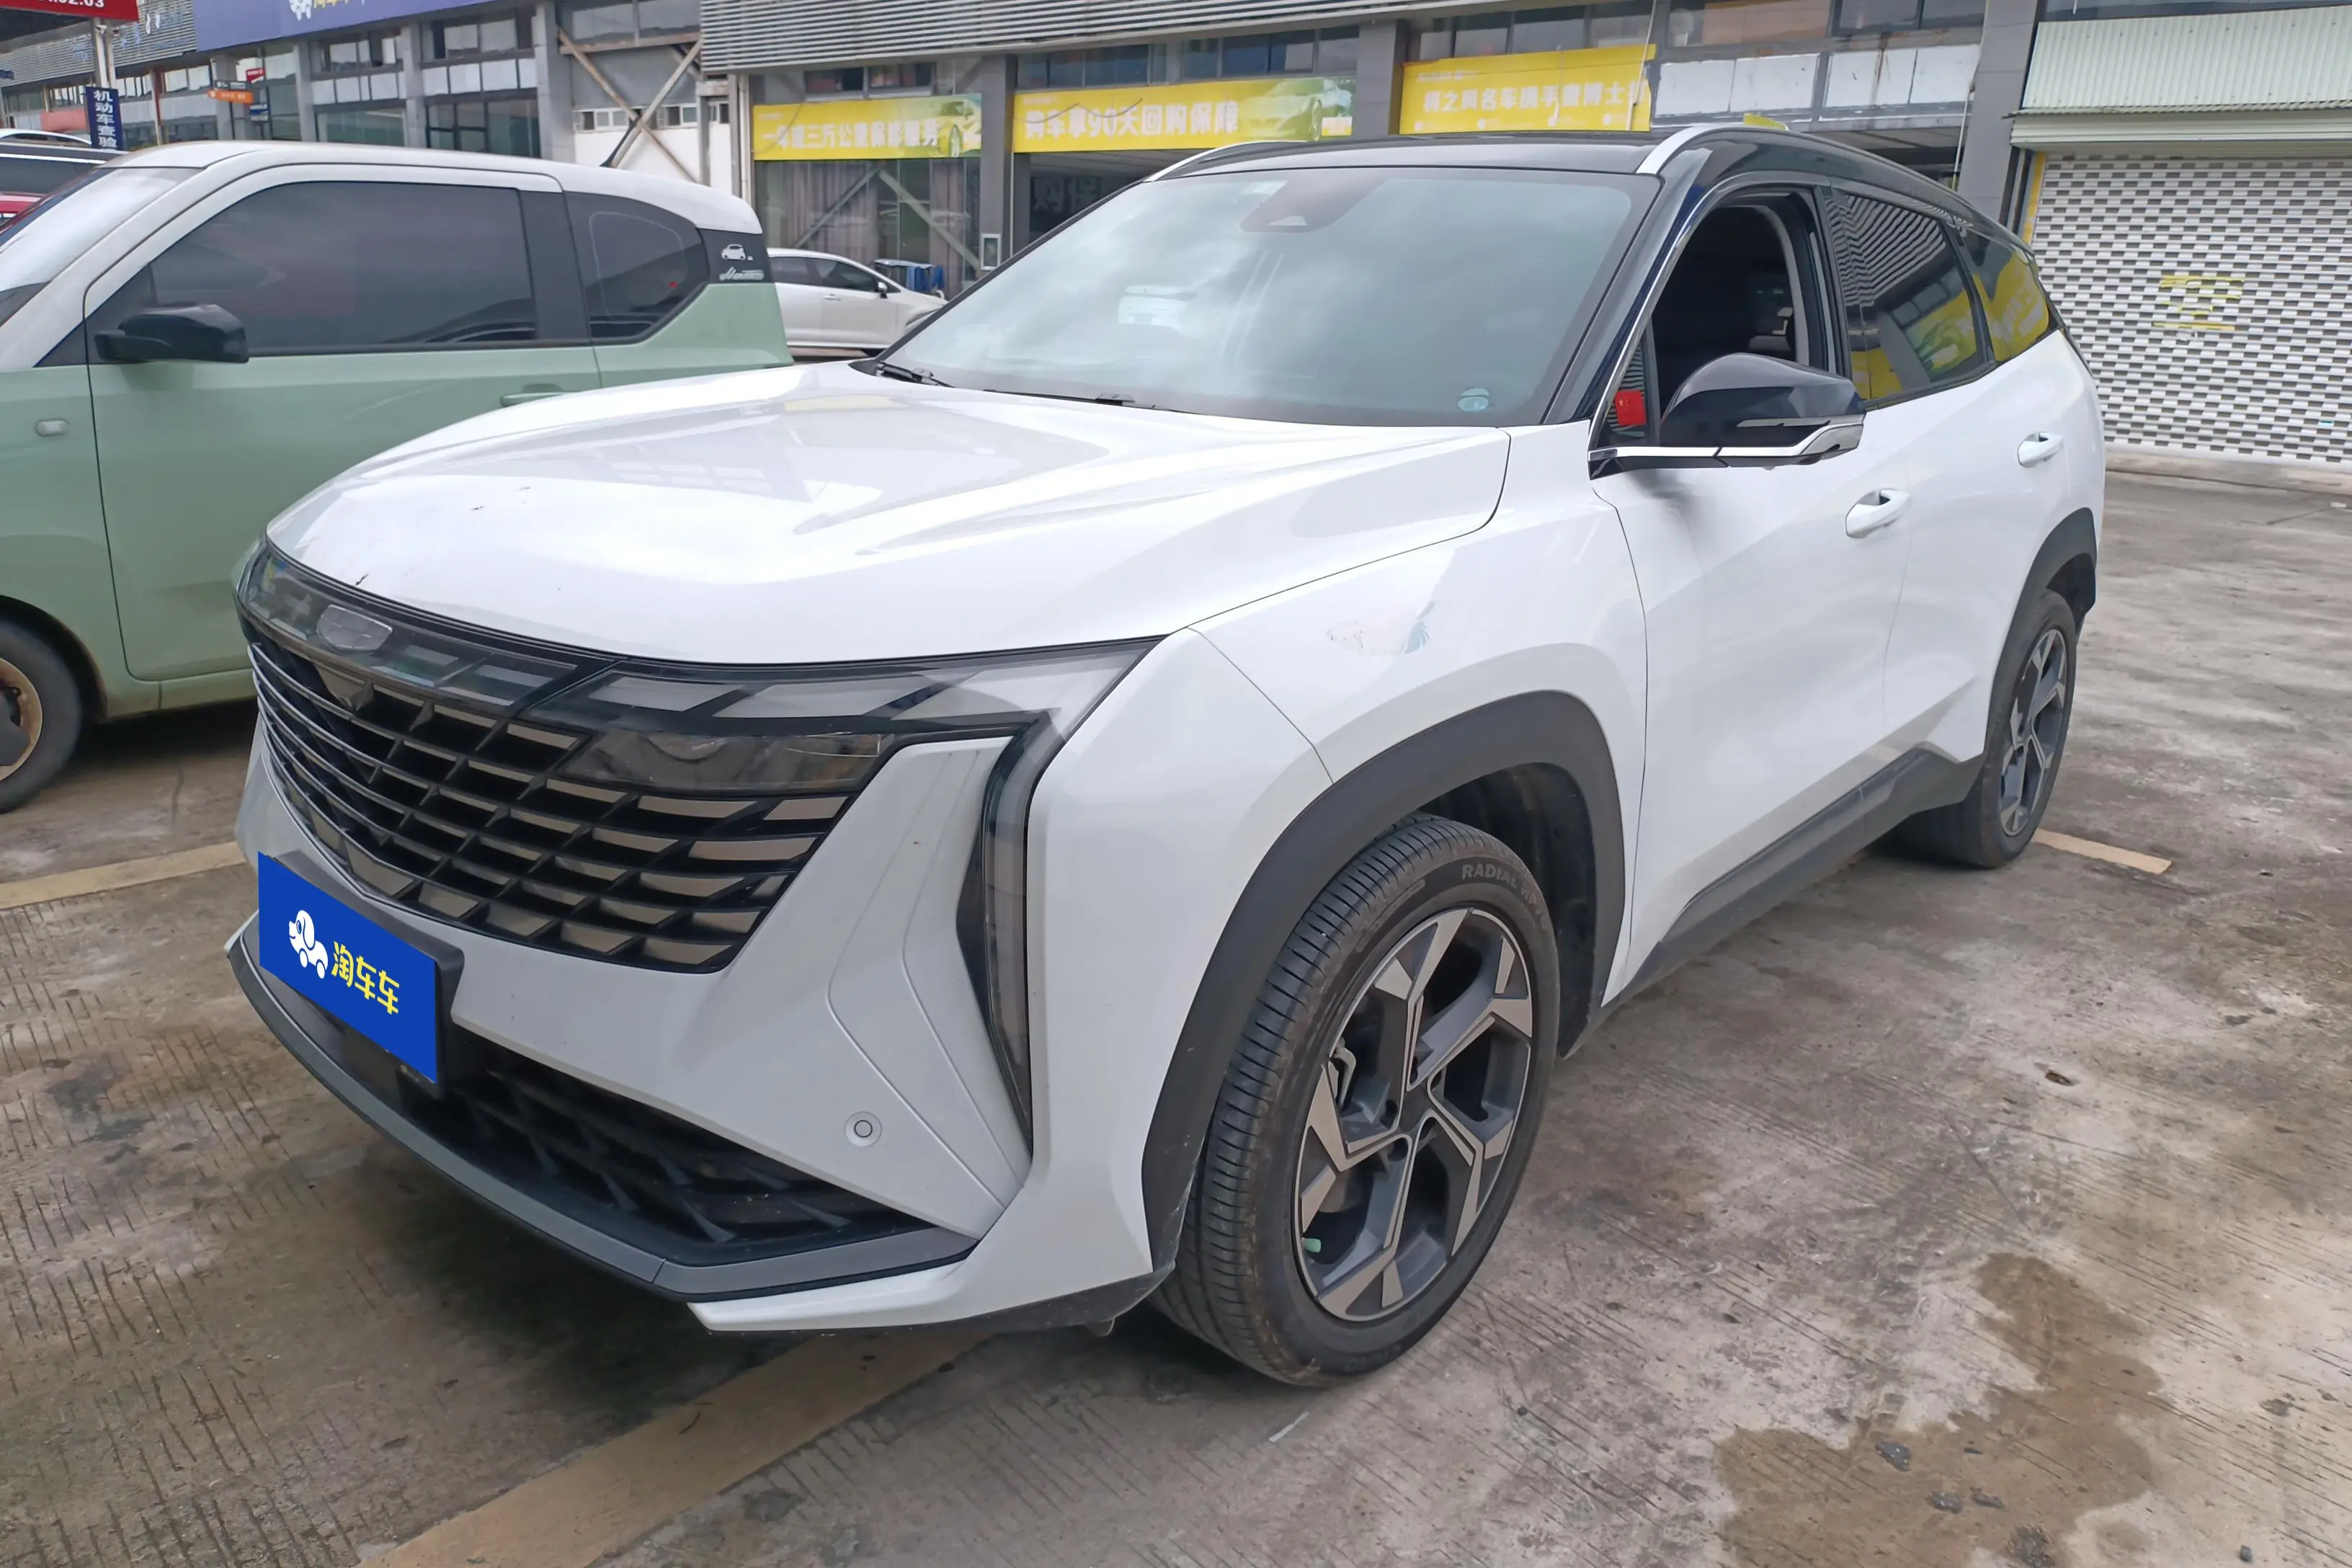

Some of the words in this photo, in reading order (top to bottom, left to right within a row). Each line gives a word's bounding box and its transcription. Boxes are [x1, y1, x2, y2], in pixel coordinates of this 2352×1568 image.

[93, 90, 117, 148] 机动车查验
[1461, 863, 1518, 889] RADIAL
